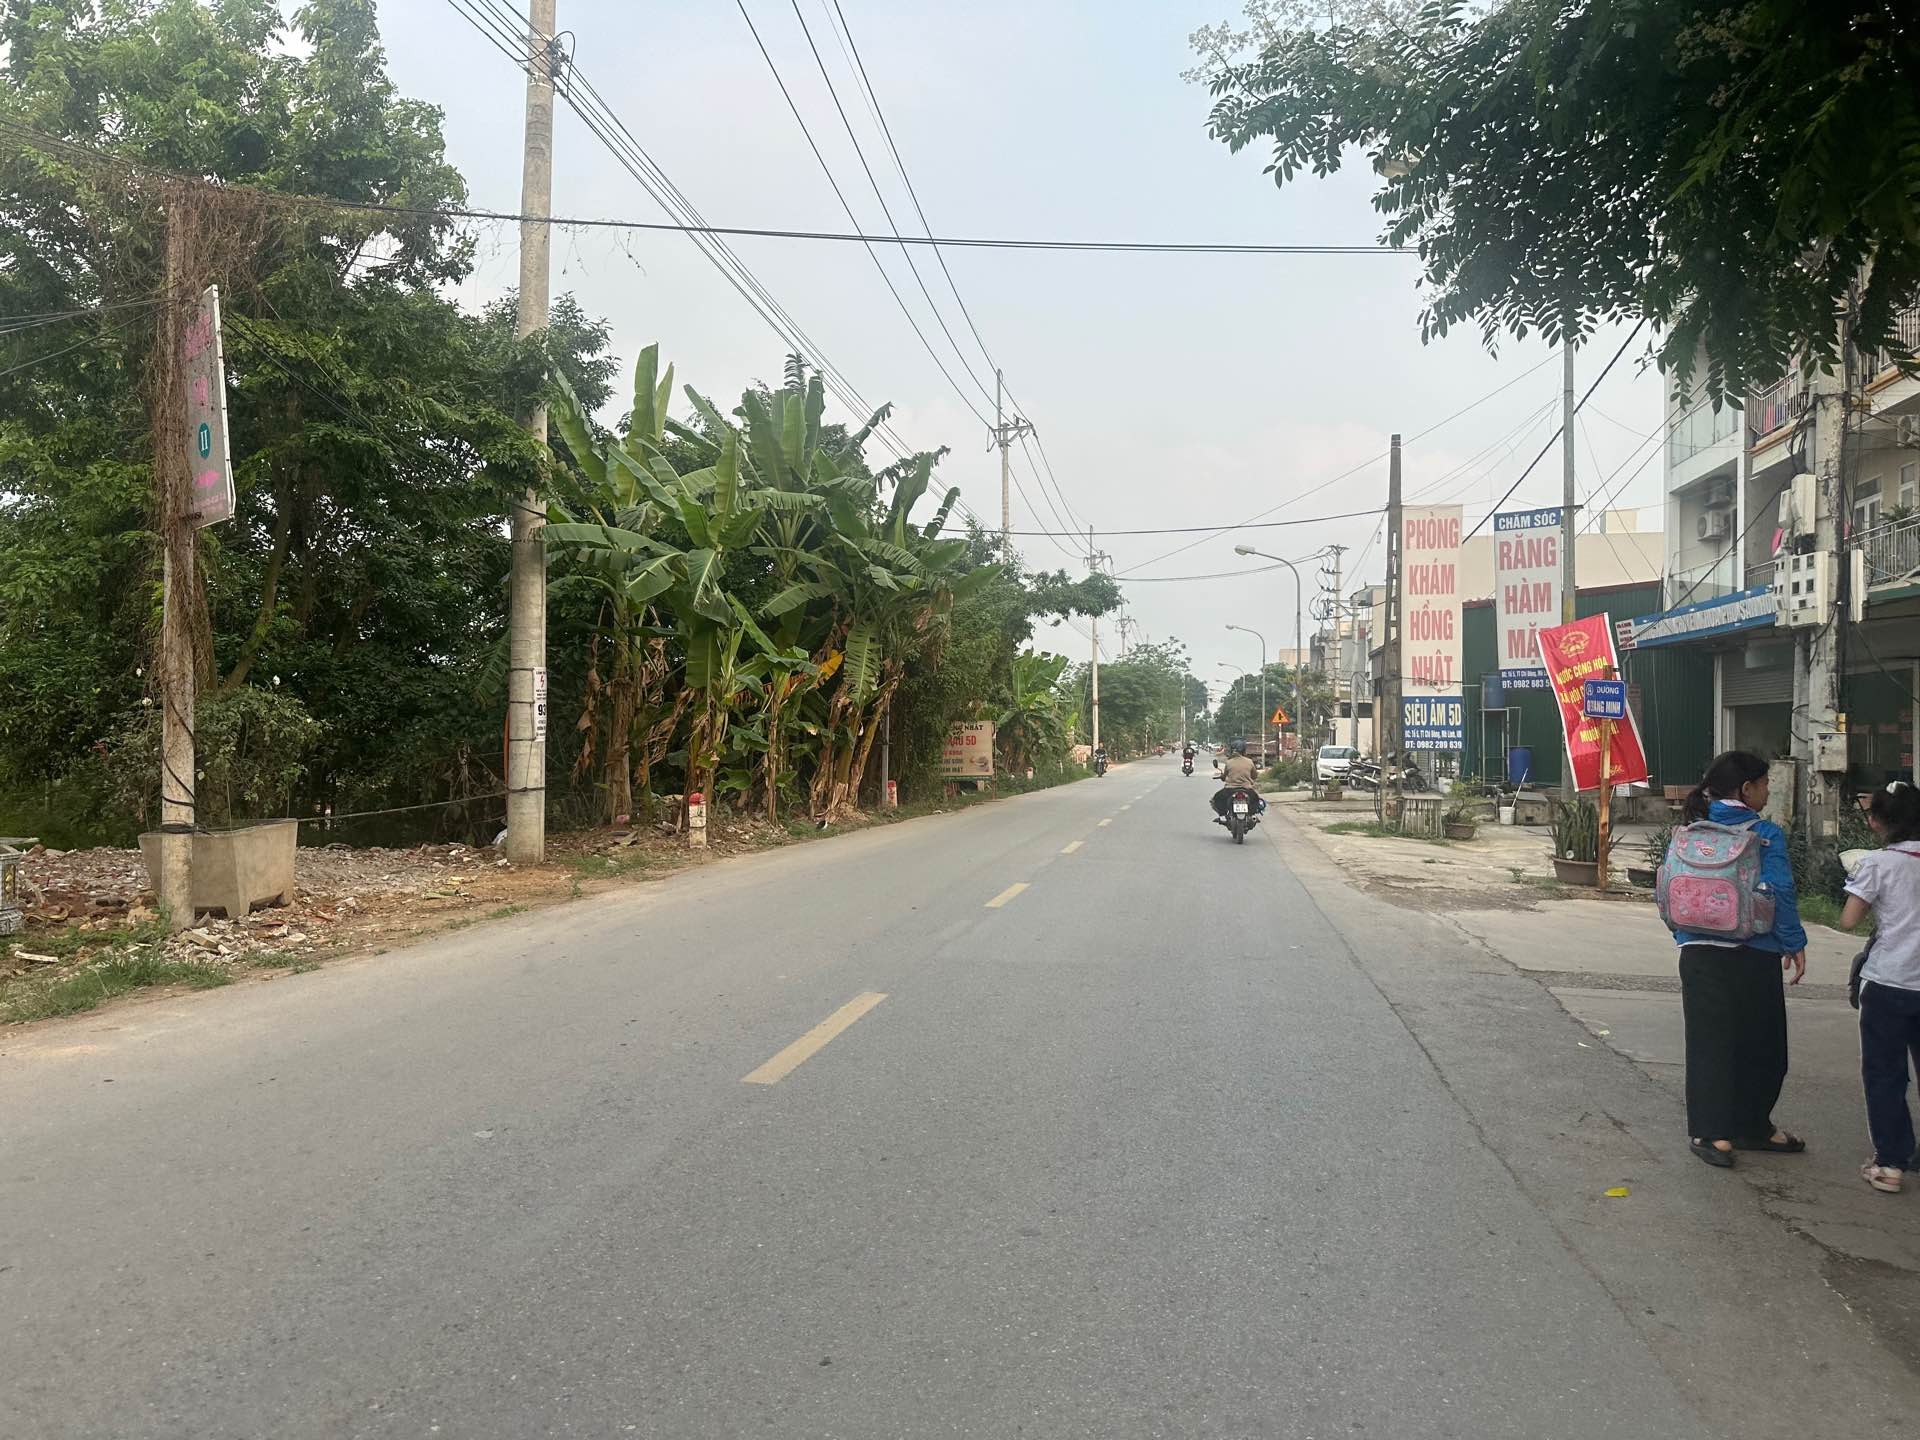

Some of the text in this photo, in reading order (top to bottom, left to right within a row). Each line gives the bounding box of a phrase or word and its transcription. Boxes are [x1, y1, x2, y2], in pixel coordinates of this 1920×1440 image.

[1498, 511, 1556, 530] CHĂM SÓC
[1499, 532, 1557, 571] RĂNG
[1409, 558, 1455, 595] KHÁM
[1504, 577, 1552, 614] HÀM
[1410, 600, 1453, 641] HỒNG
[1507, 621, 1547, 665] MẶ
[1513, 680, 1530, 689] 0982
[1405, 698, 1461, 726] SIÊU ÂM 5D
